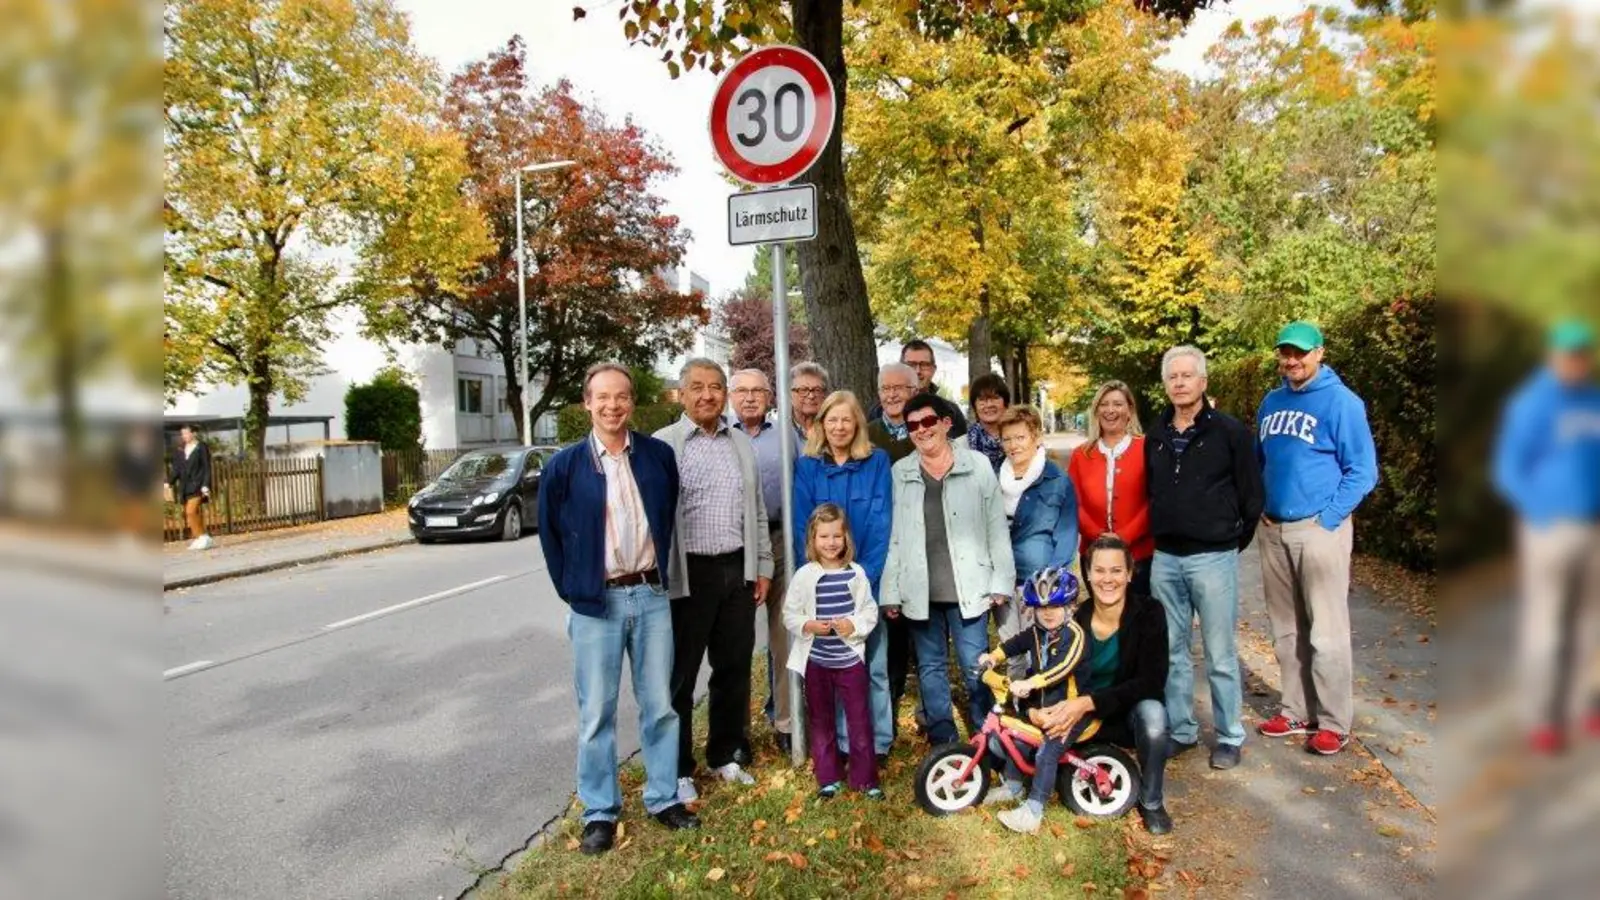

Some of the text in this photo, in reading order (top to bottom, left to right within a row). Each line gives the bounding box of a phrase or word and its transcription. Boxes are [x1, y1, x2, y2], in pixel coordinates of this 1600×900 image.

[736, 82, 806, 147] 30
[735, 207, 808, 228] Lärmschutz
[1260, 410, 1318, 444] DUKE
